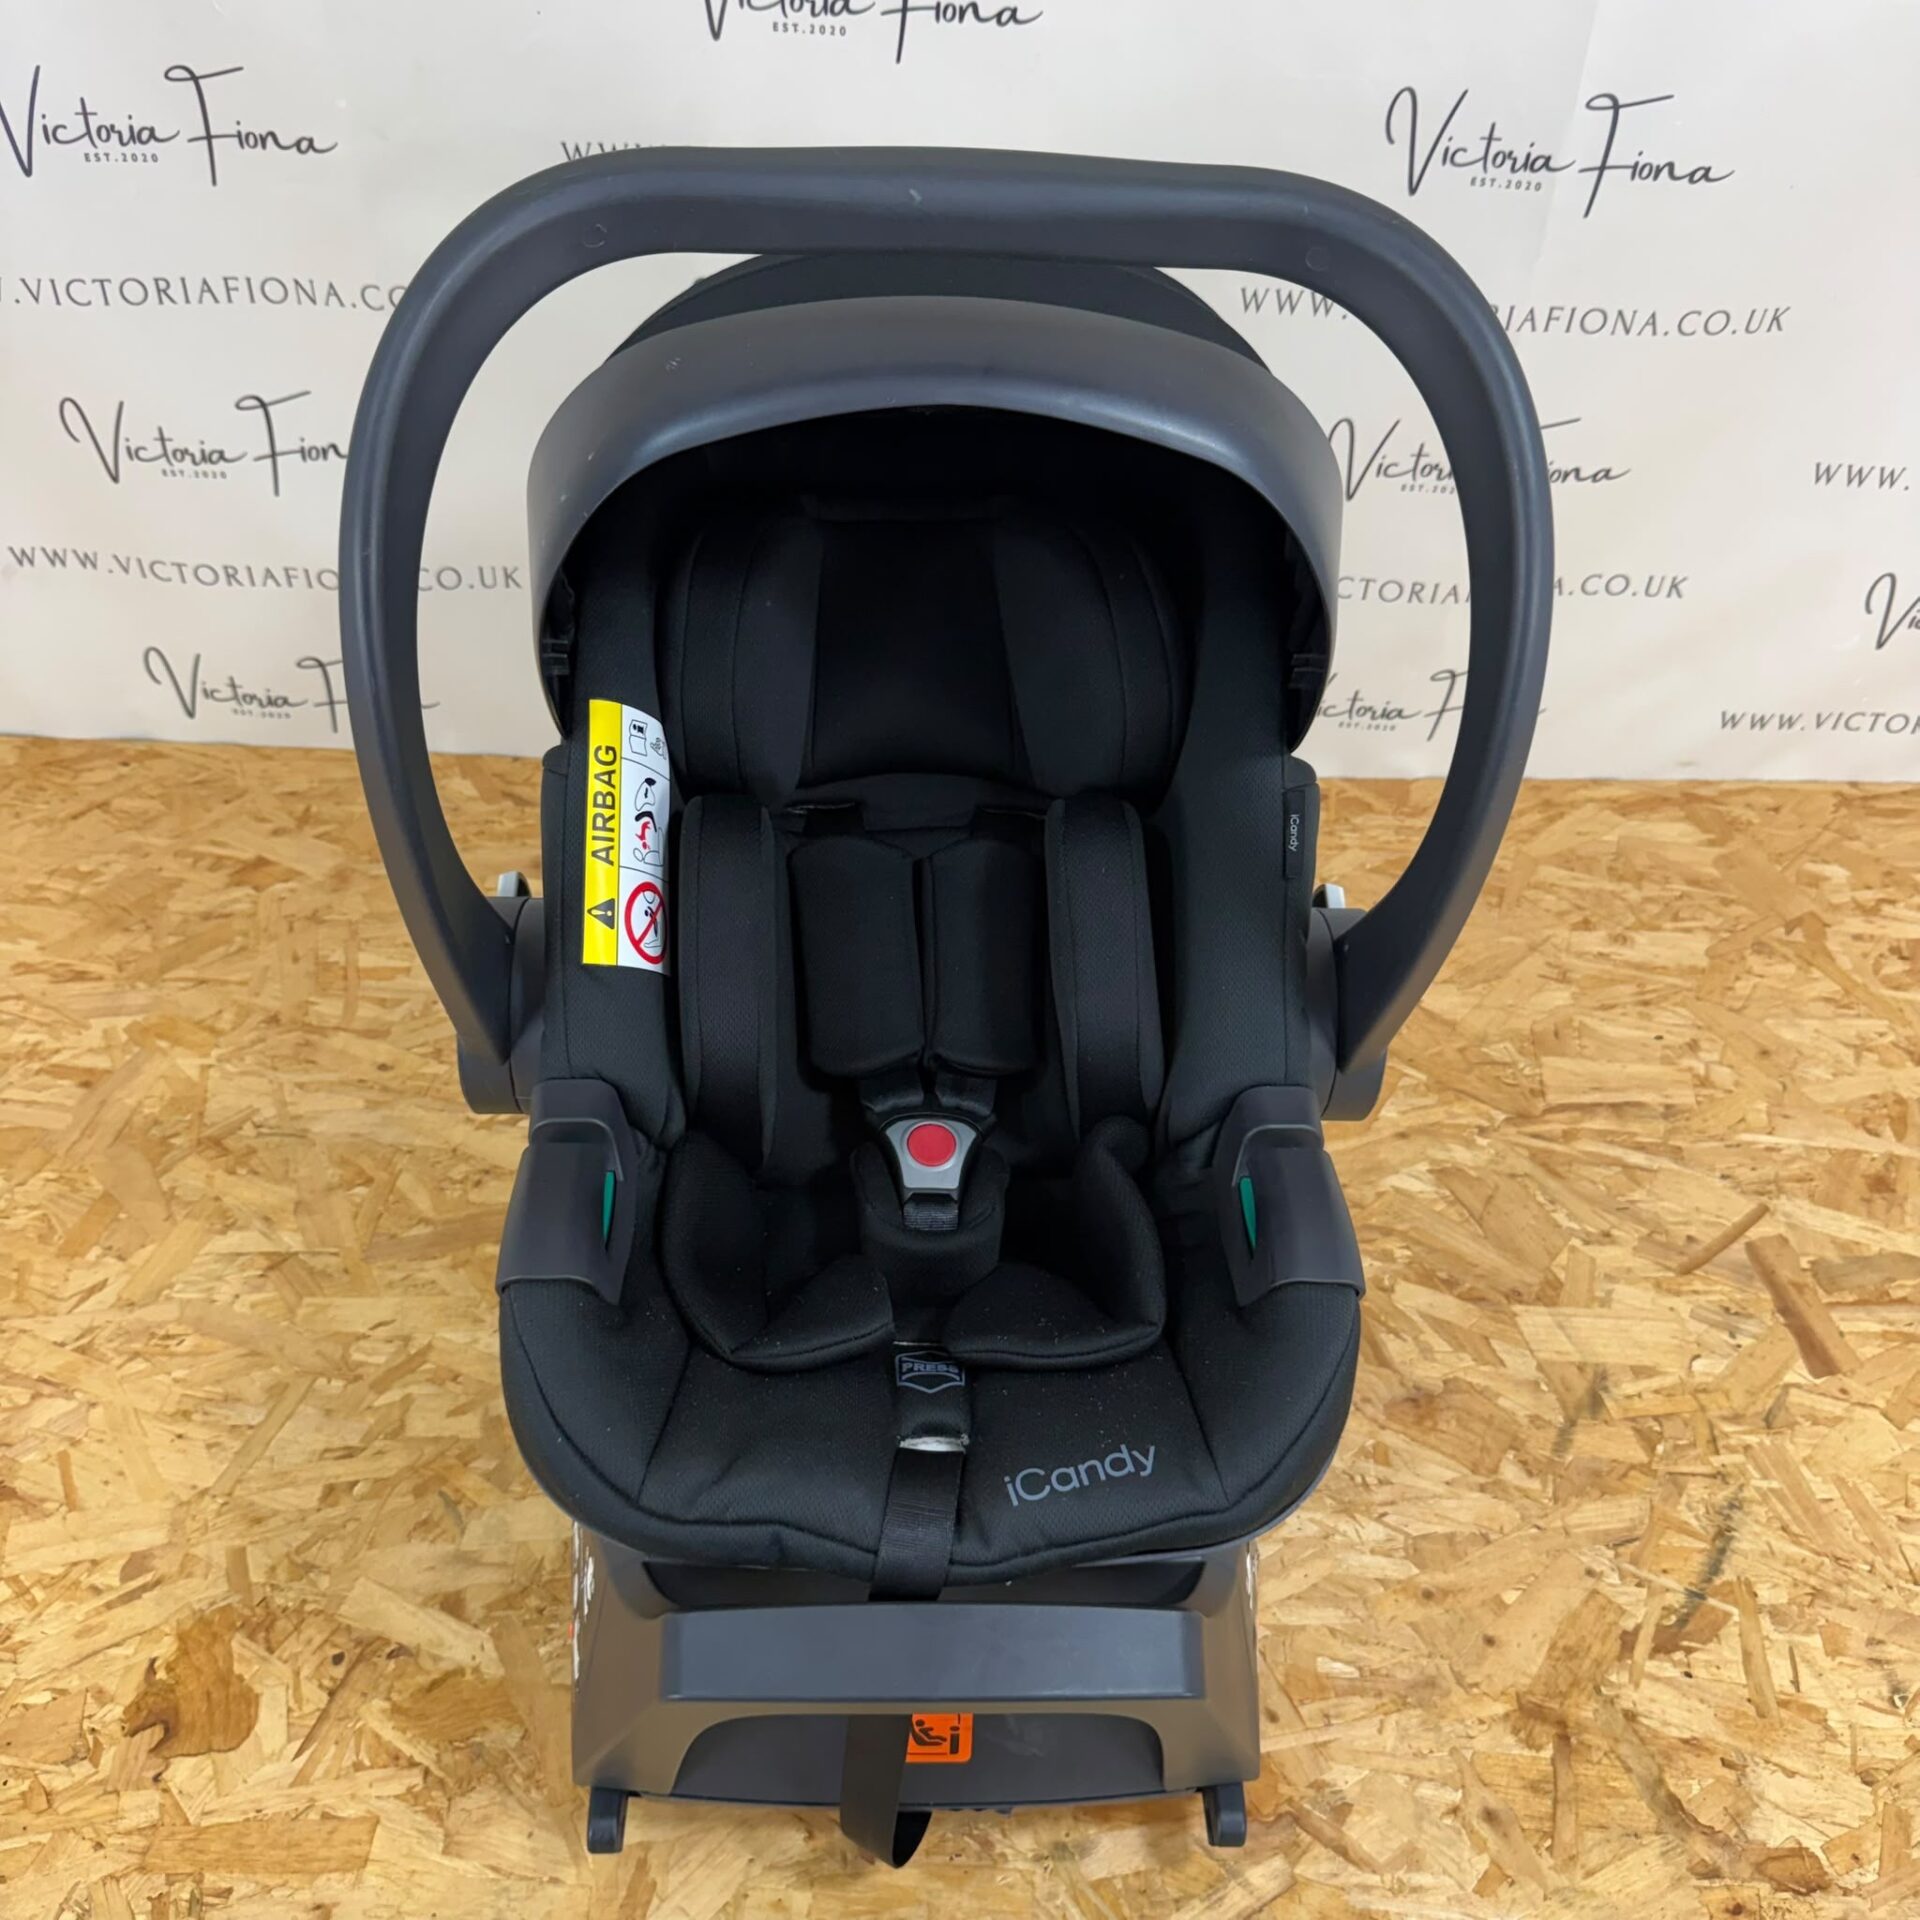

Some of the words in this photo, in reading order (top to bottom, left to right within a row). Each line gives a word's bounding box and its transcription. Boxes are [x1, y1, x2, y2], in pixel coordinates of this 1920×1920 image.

[772, 21, 847, 36] EST.2020
[0, 64, 181, 178] Victoria
[163, 65, 338, 187] Fiona
[84, 152, 159, 163] EST.2020
[1385, 86, 1576, 197] Victoria
[1577, 92, 1736, 219] Fiona
[1470, 176, 1542, 192] EST.2020
[59, 395, 248, 484] Victoria
[234, 390, 348, 497] Fion
[1815, 462, 1909, 491] WWW.
[143, 646, 308, 719] Victoria
[592, 745, 617, 867] AIRBAG
[1288, 813, 1300, 852] iCandy
[902, 1362, 960, 1374] PRESS
[1004, 1444, 1156, 1507] iCandy
